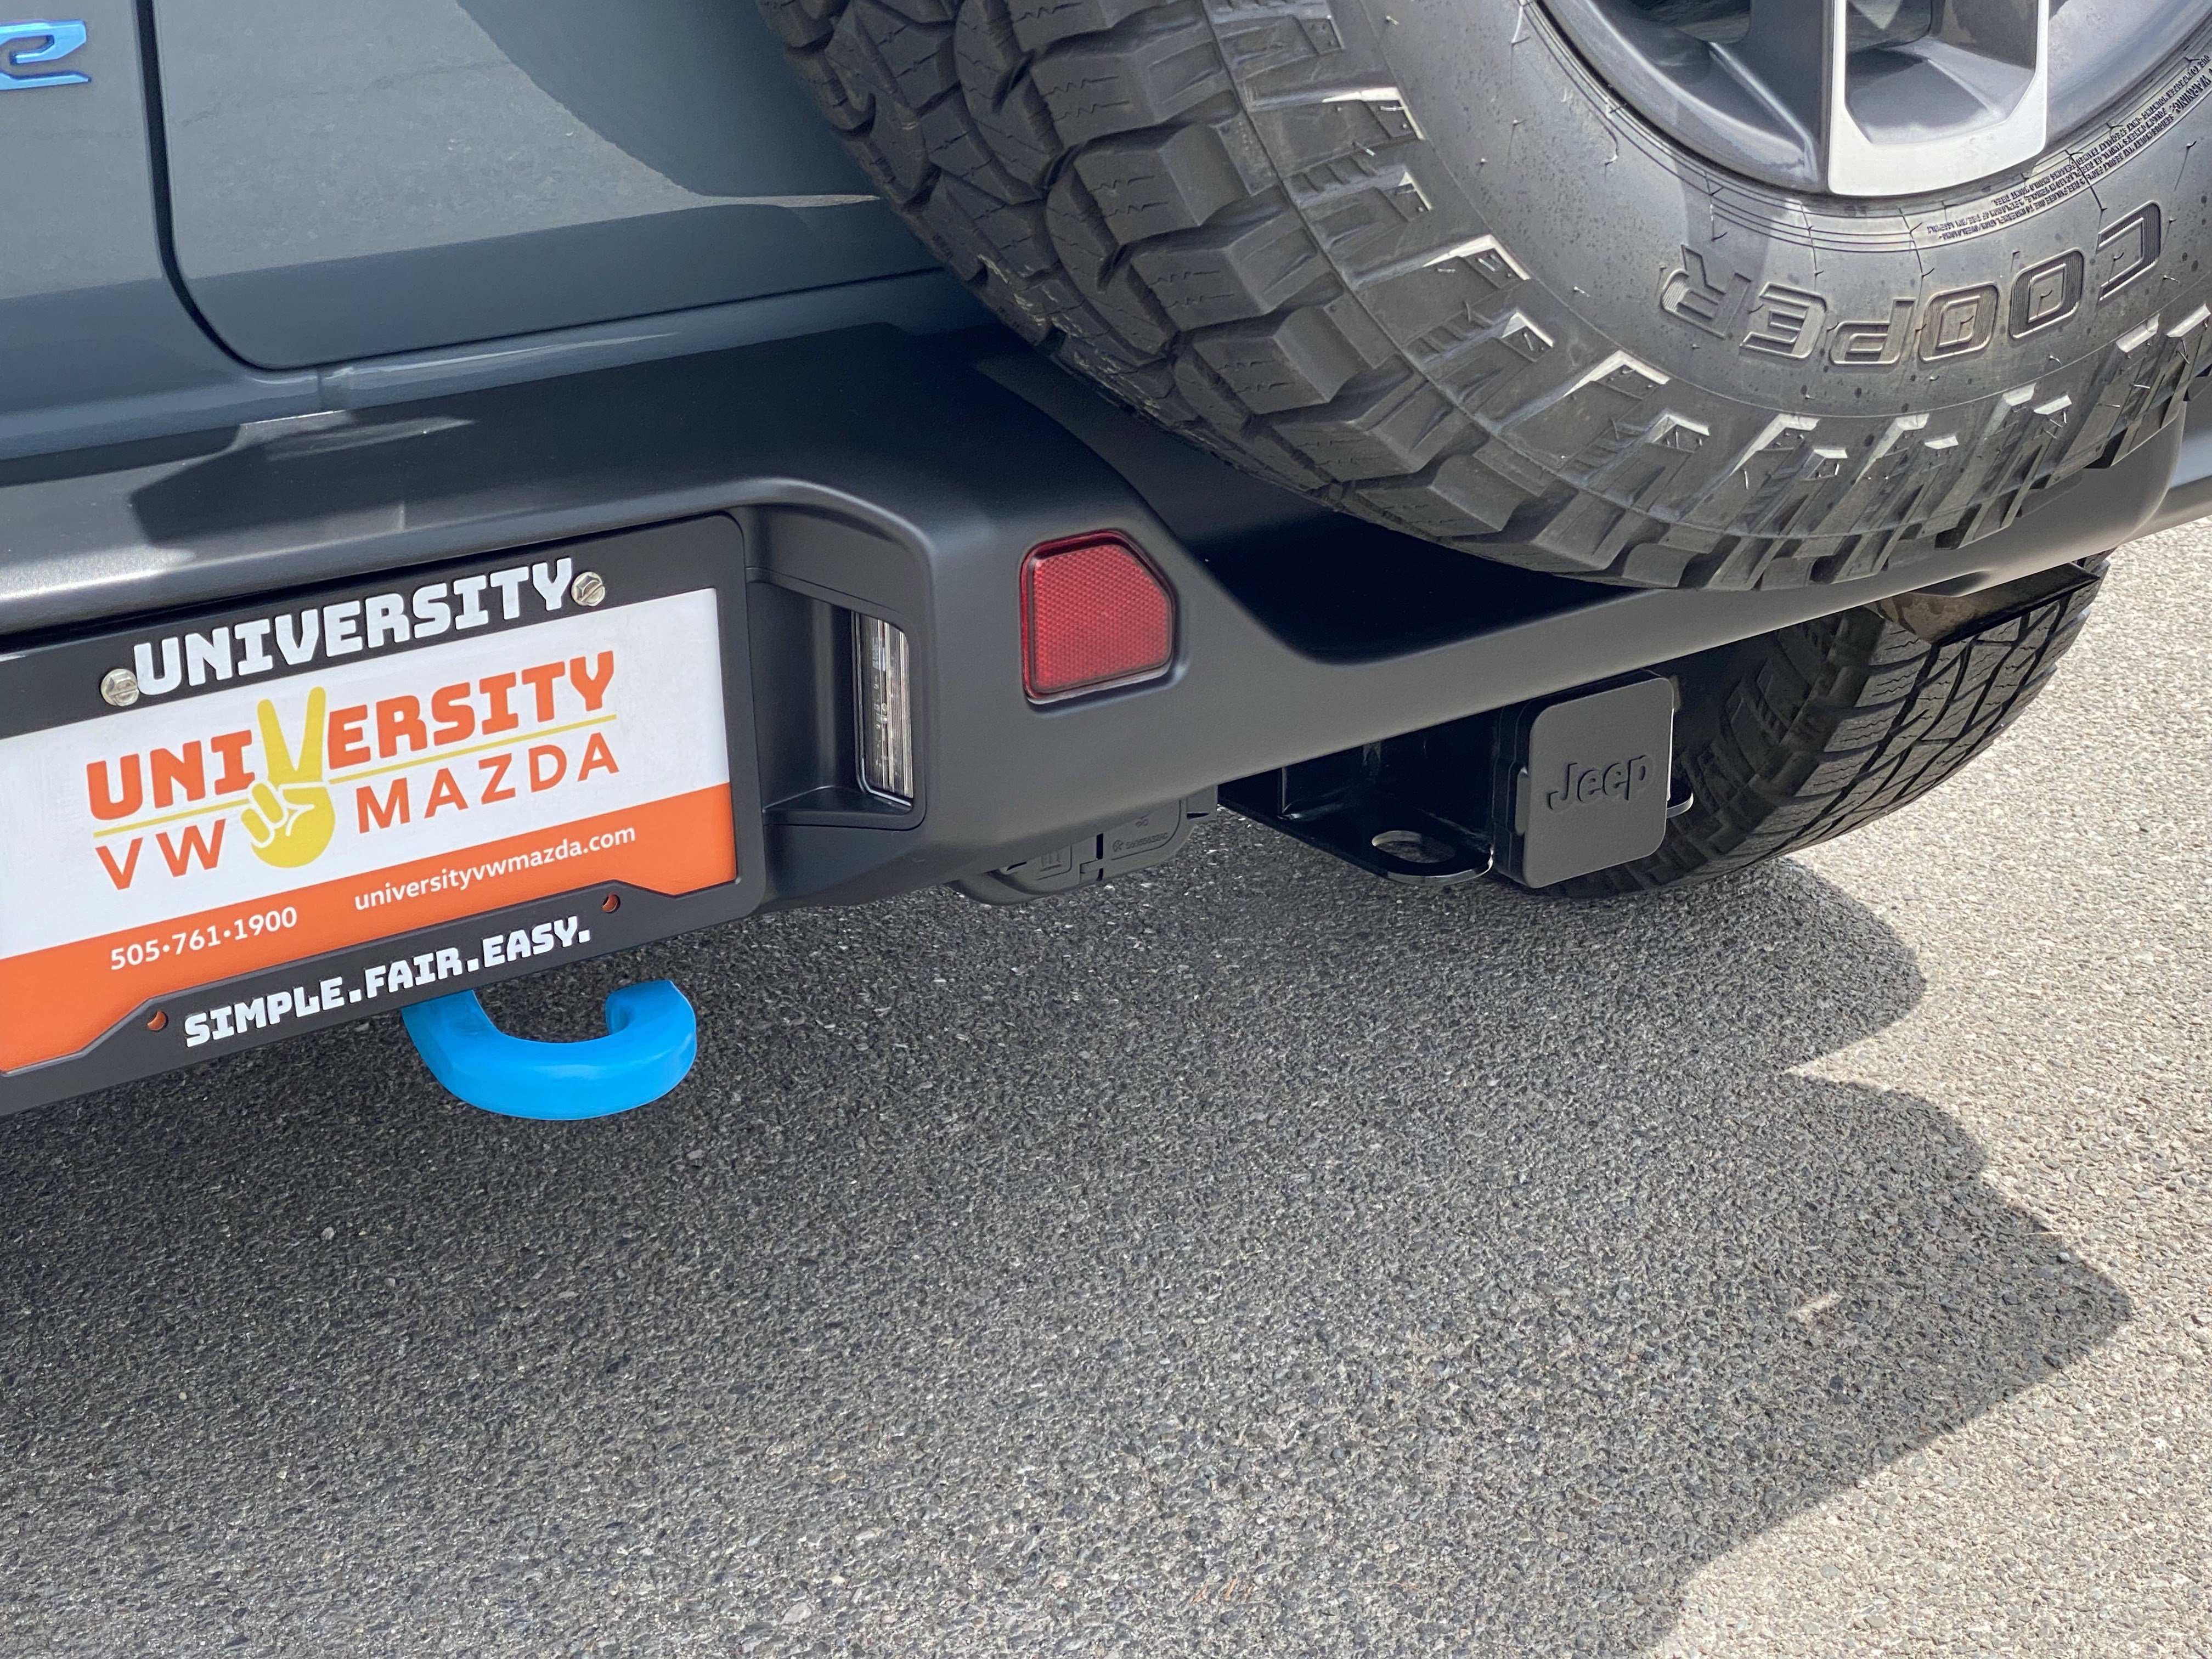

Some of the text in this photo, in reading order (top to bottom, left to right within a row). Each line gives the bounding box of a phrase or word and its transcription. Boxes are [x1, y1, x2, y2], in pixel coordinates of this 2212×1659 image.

[1661, 201, 2162, 366] COOPER
[133, 557, 572, 696] UNIVERSITY
[87, 651, 614, 820] UNIVERSITY
[1546, 754, 1654, 811] Jeep
[97, 733, 618, 889] VW MAZDA
[354, 824, 636, 911] universityvwmazda.com
